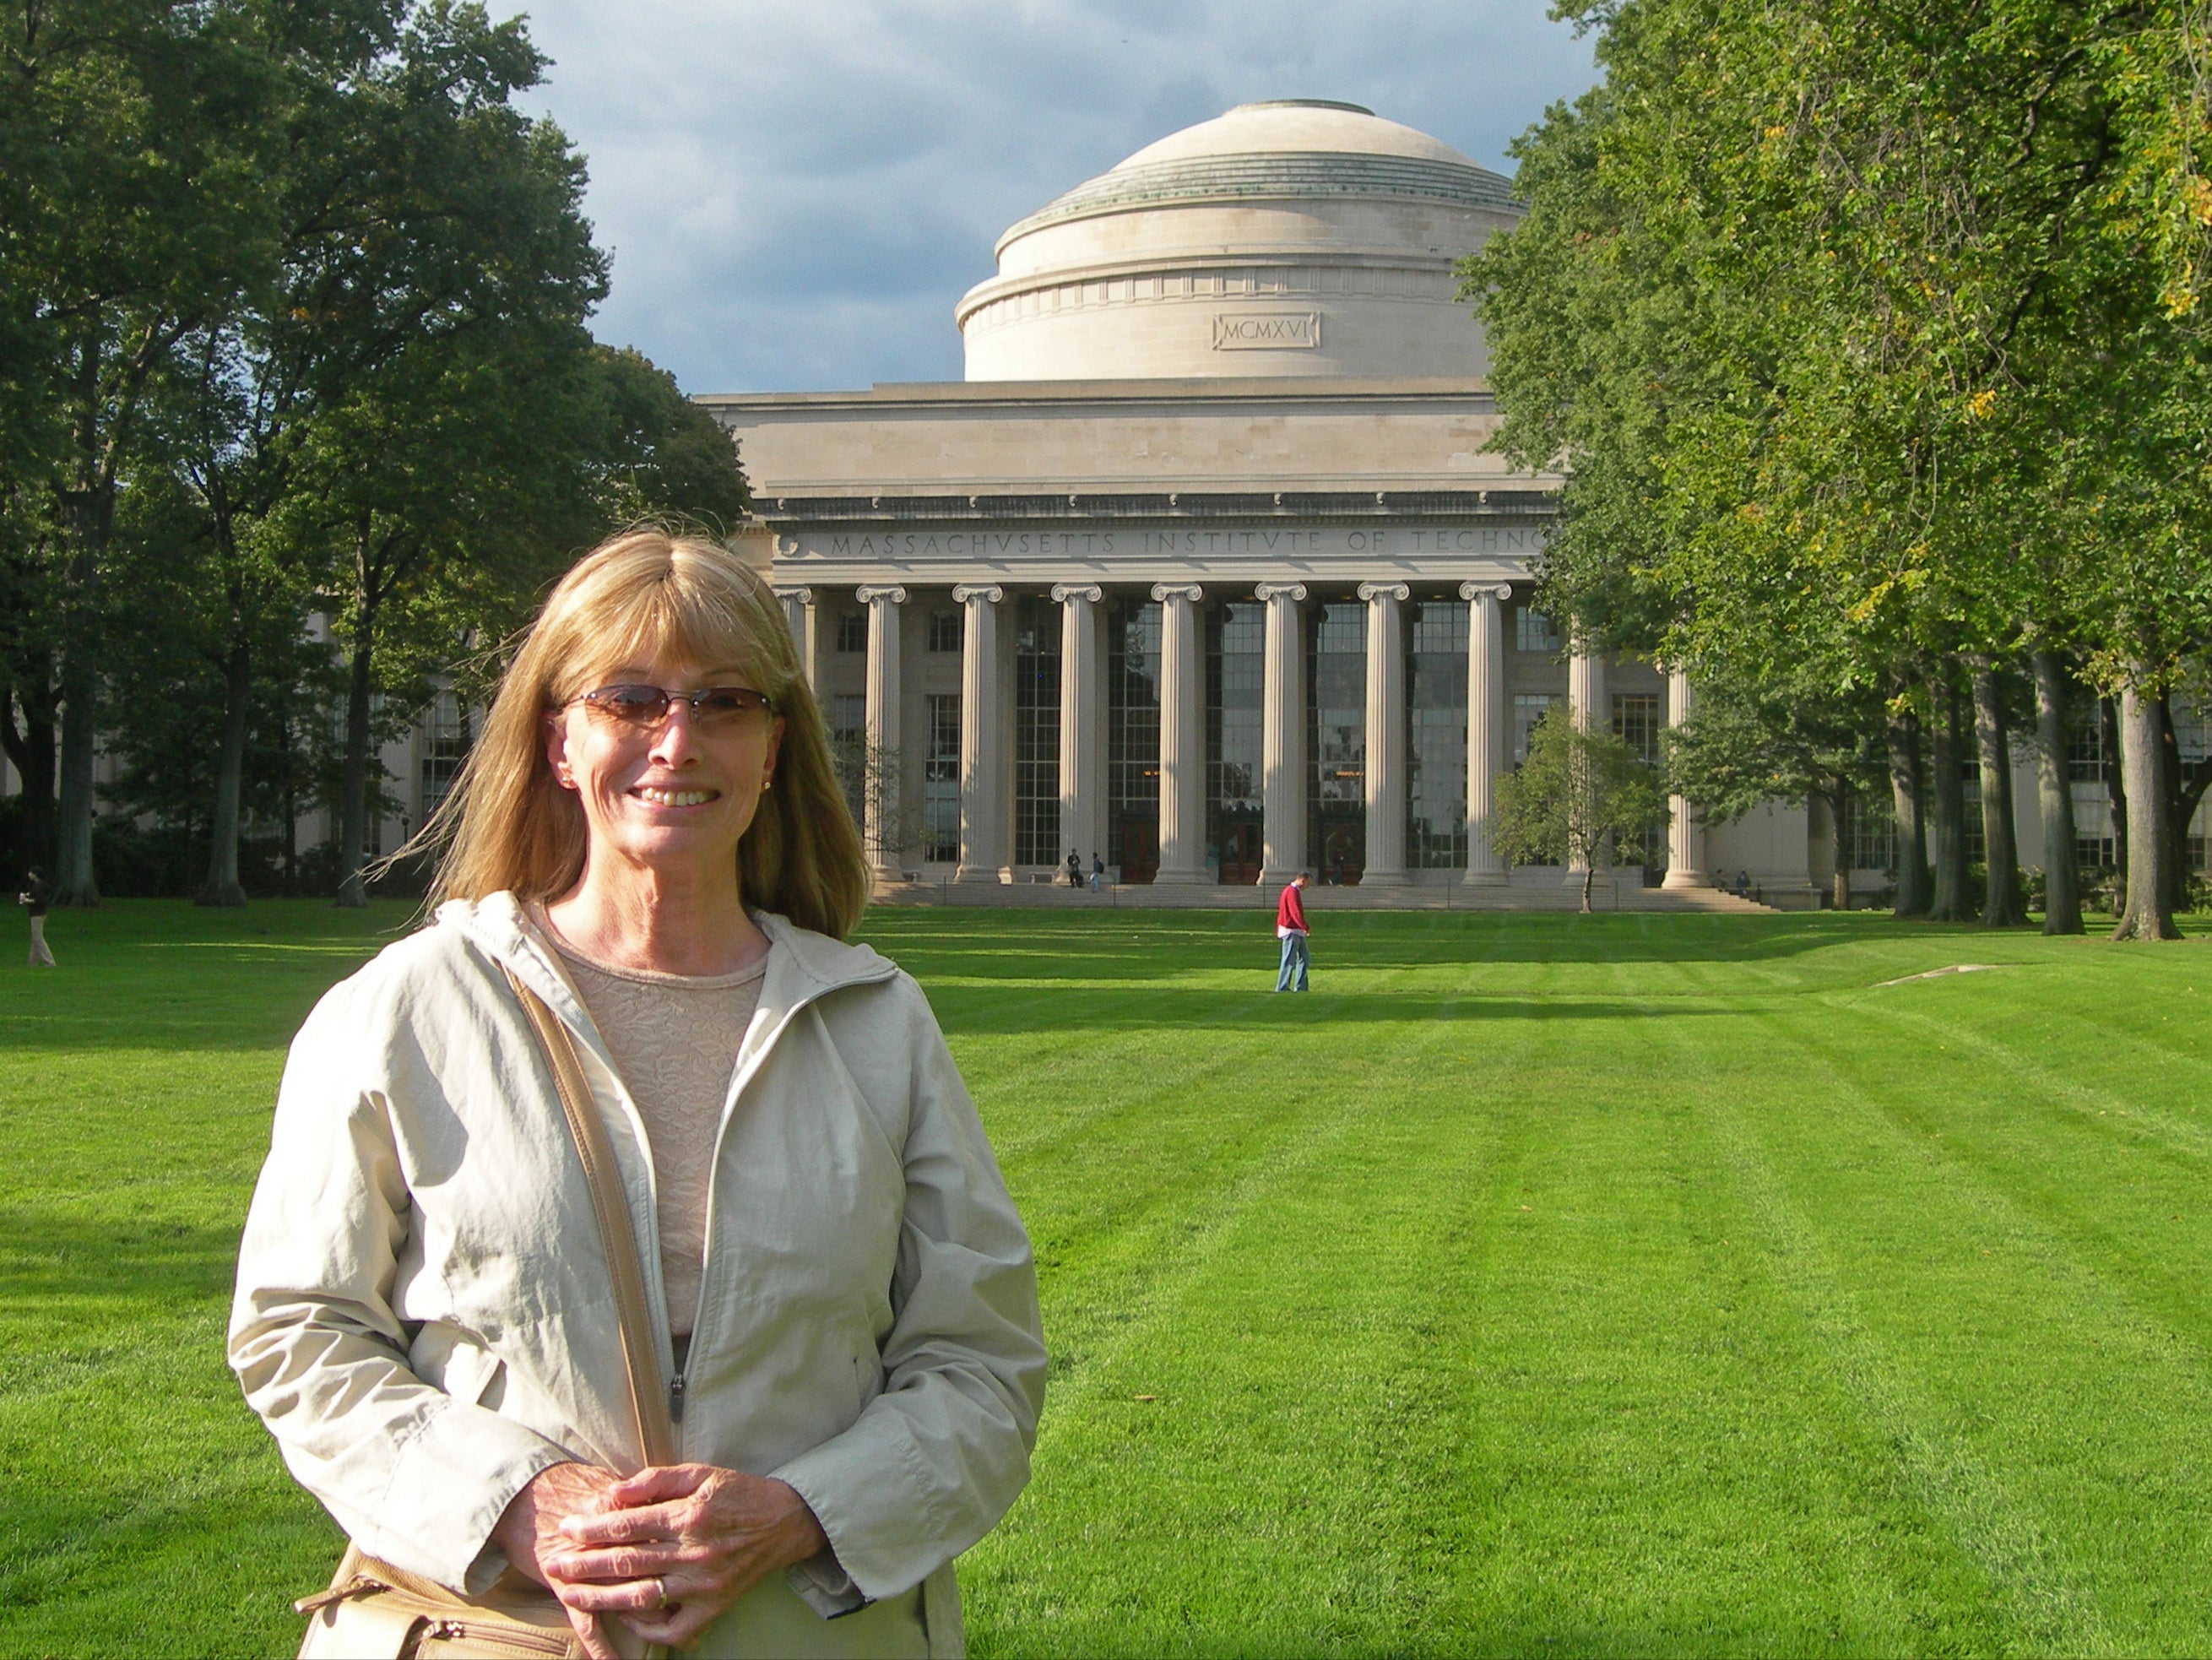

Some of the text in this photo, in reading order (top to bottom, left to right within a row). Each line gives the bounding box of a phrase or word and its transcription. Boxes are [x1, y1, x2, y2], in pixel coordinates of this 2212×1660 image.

[1223, 320, 1307, 339] MCMXVI
[832, 534, 1114, 555] MASSACHVSETTS
[1144, 531, 1321, 552] INSTITVTE
[1347, 531, 1385, 551] OF
